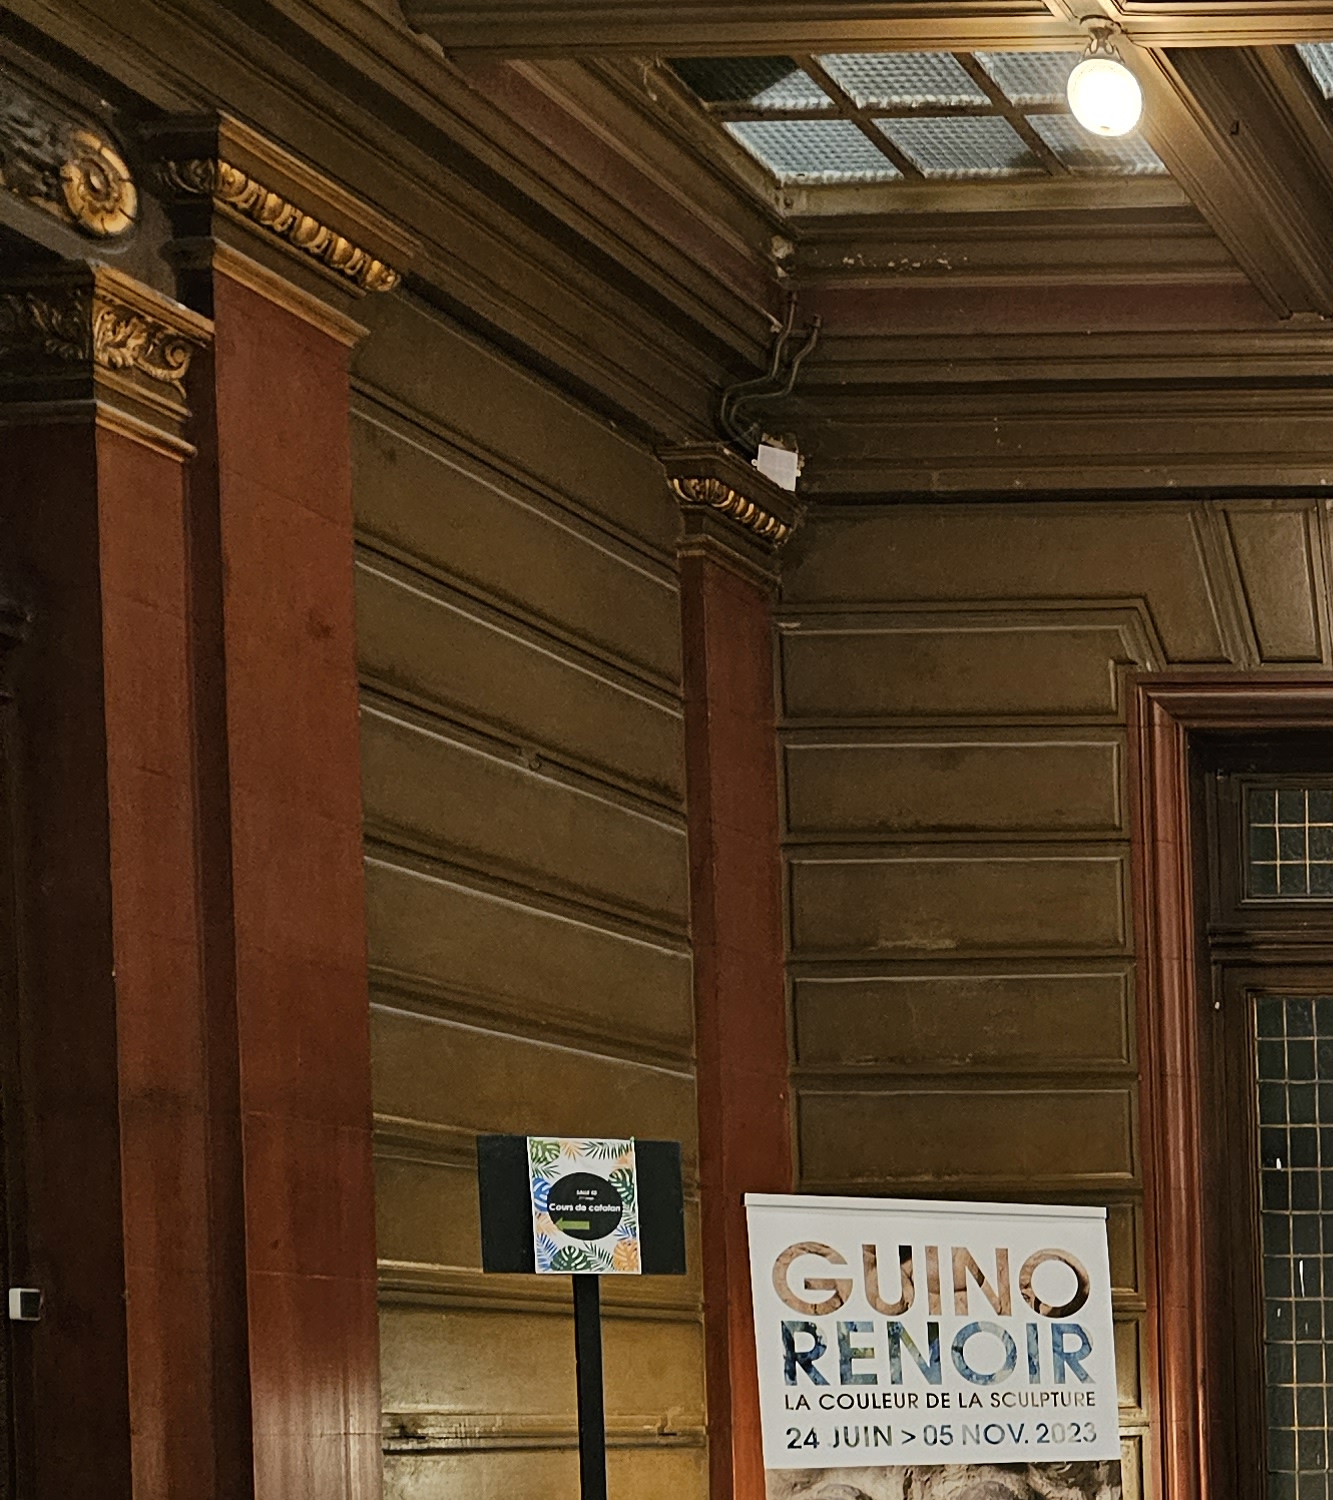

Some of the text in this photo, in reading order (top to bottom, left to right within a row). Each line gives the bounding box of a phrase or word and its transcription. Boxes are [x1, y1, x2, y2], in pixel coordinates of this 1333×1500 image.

[549, 1203, 573, 1211] Cours
[588, 1204, 621, 1212] catalan
[772, 1241, 1090, 1318] GUINO
[781, 1321, 1096, 1386] RENOIR
[785, 1391, 1096, 1411] LA COULEUR DE LA SCULPTURE
[786, 1427, 819, 1449] 24
[830, 1424, 893, 1448] JUIN
[923, 1424, 954, 1446] 05
[962, 1423, 1029, 1445] NOV.
[1037, 1422, 1097, 1444] 2023
